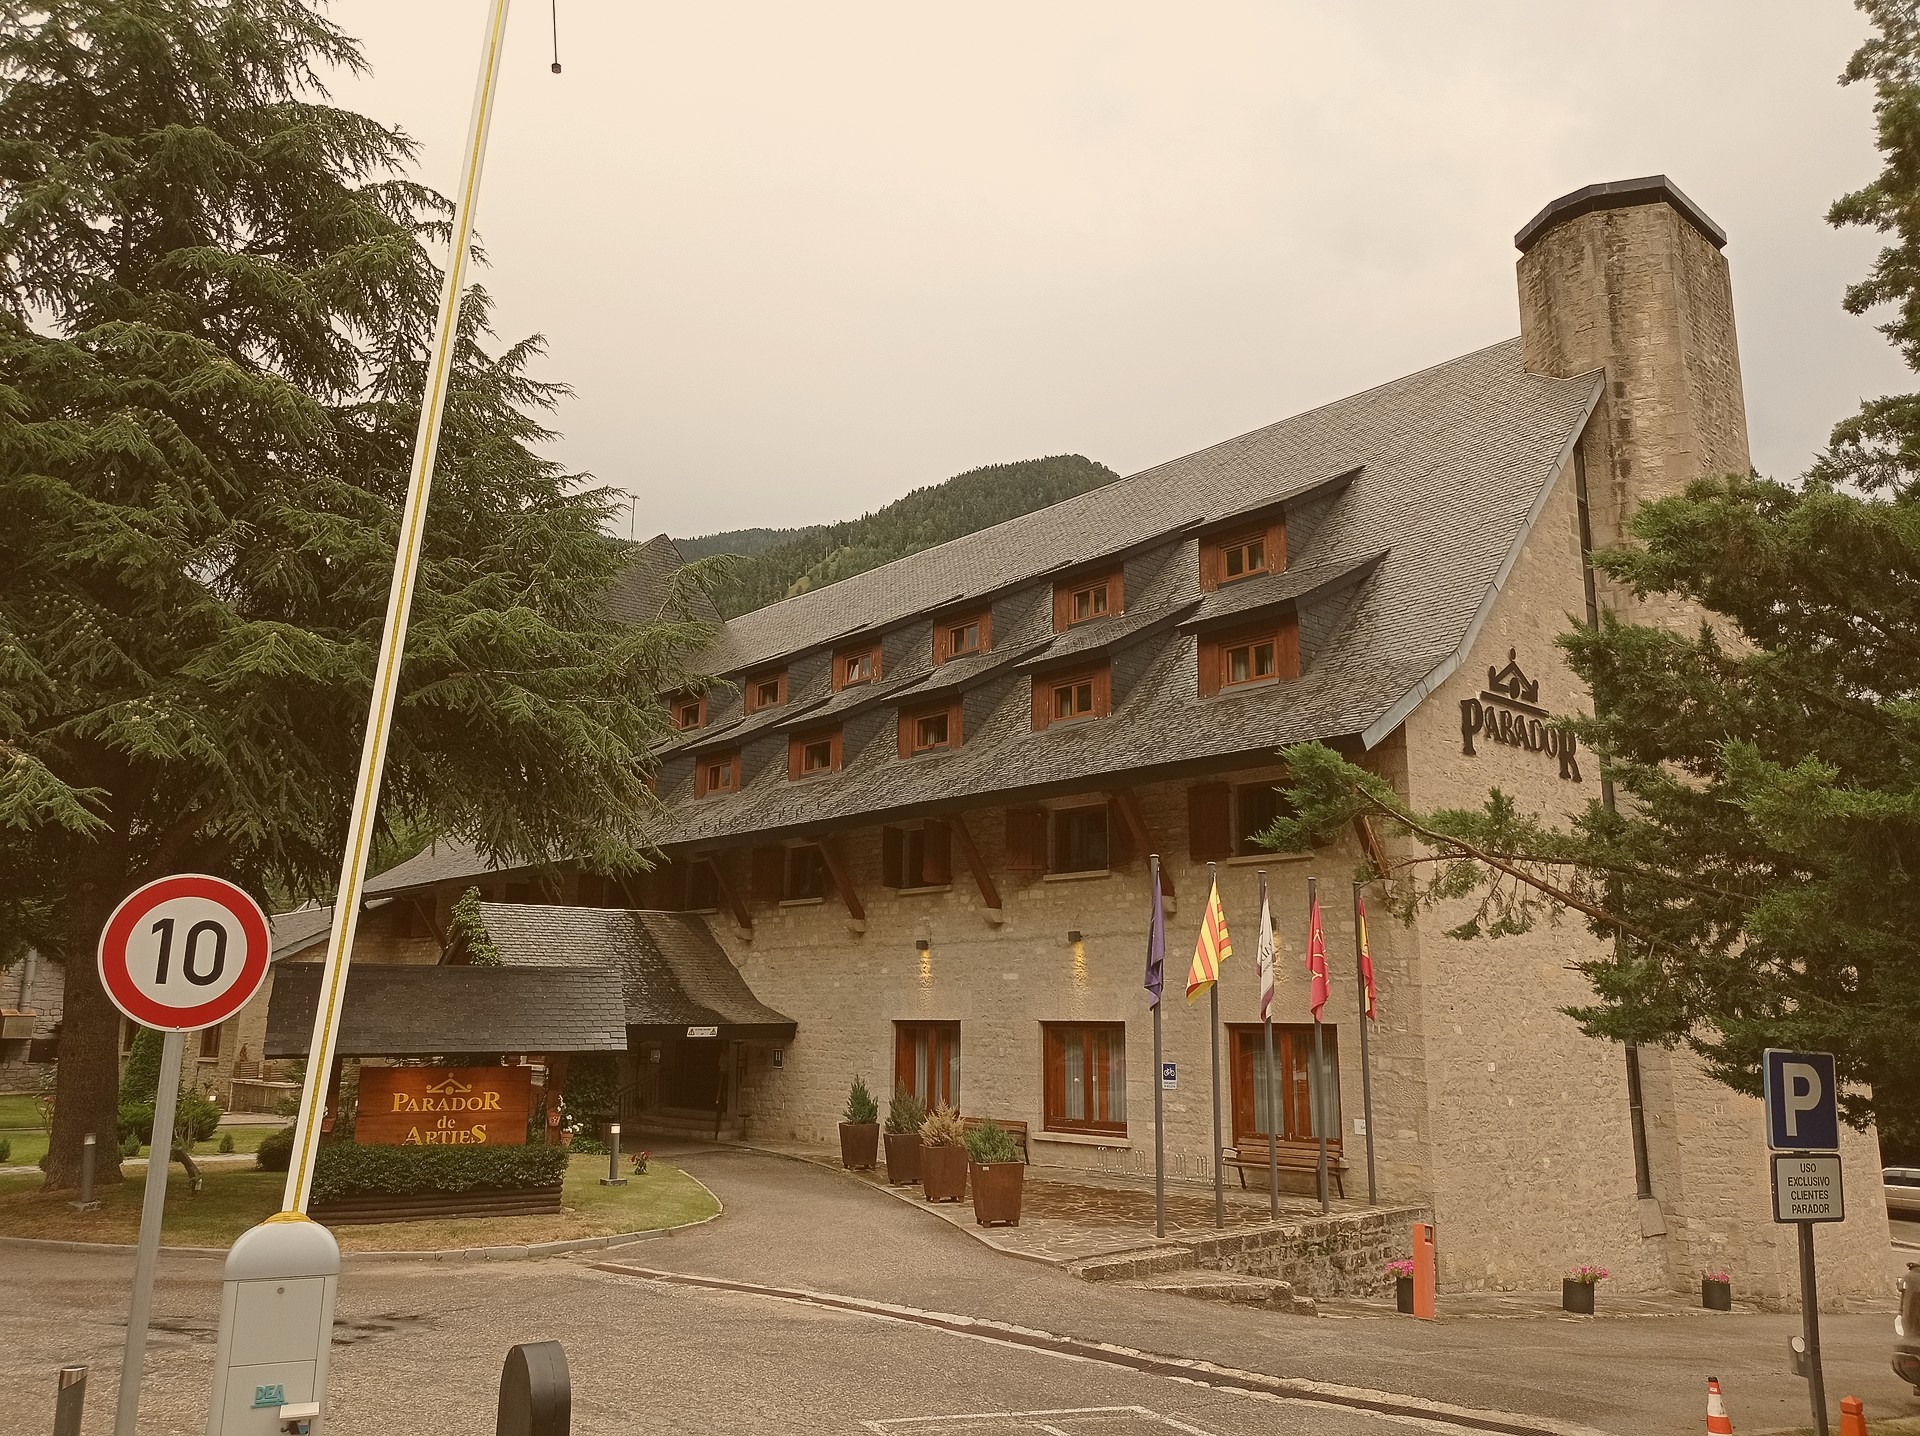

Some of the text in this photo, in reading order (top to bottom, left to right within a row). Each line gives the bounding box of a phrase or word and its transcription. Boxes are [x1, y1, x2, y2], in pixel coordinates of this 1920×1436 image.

[1460, 698, 1582, 783] PARADOR
[151, 918, 227, 986] 10
[391, 1091, 502, 1112] PARADOR
[1782, 1062, 1821, 1137] P
[436, 1115, 456, 1129] de
[401, 1124, 487, 1146] ARTIES
[1800, 1163, 1817, 1173] USO
[1787, 1176, 1830, 1187] EXCLUSIVO
[1790, 1190, 1829, 1200] CLIENTES
[1791, 1203, 1830, 1214] PARADOR
[255, 1384, 285, 1403] DEA
